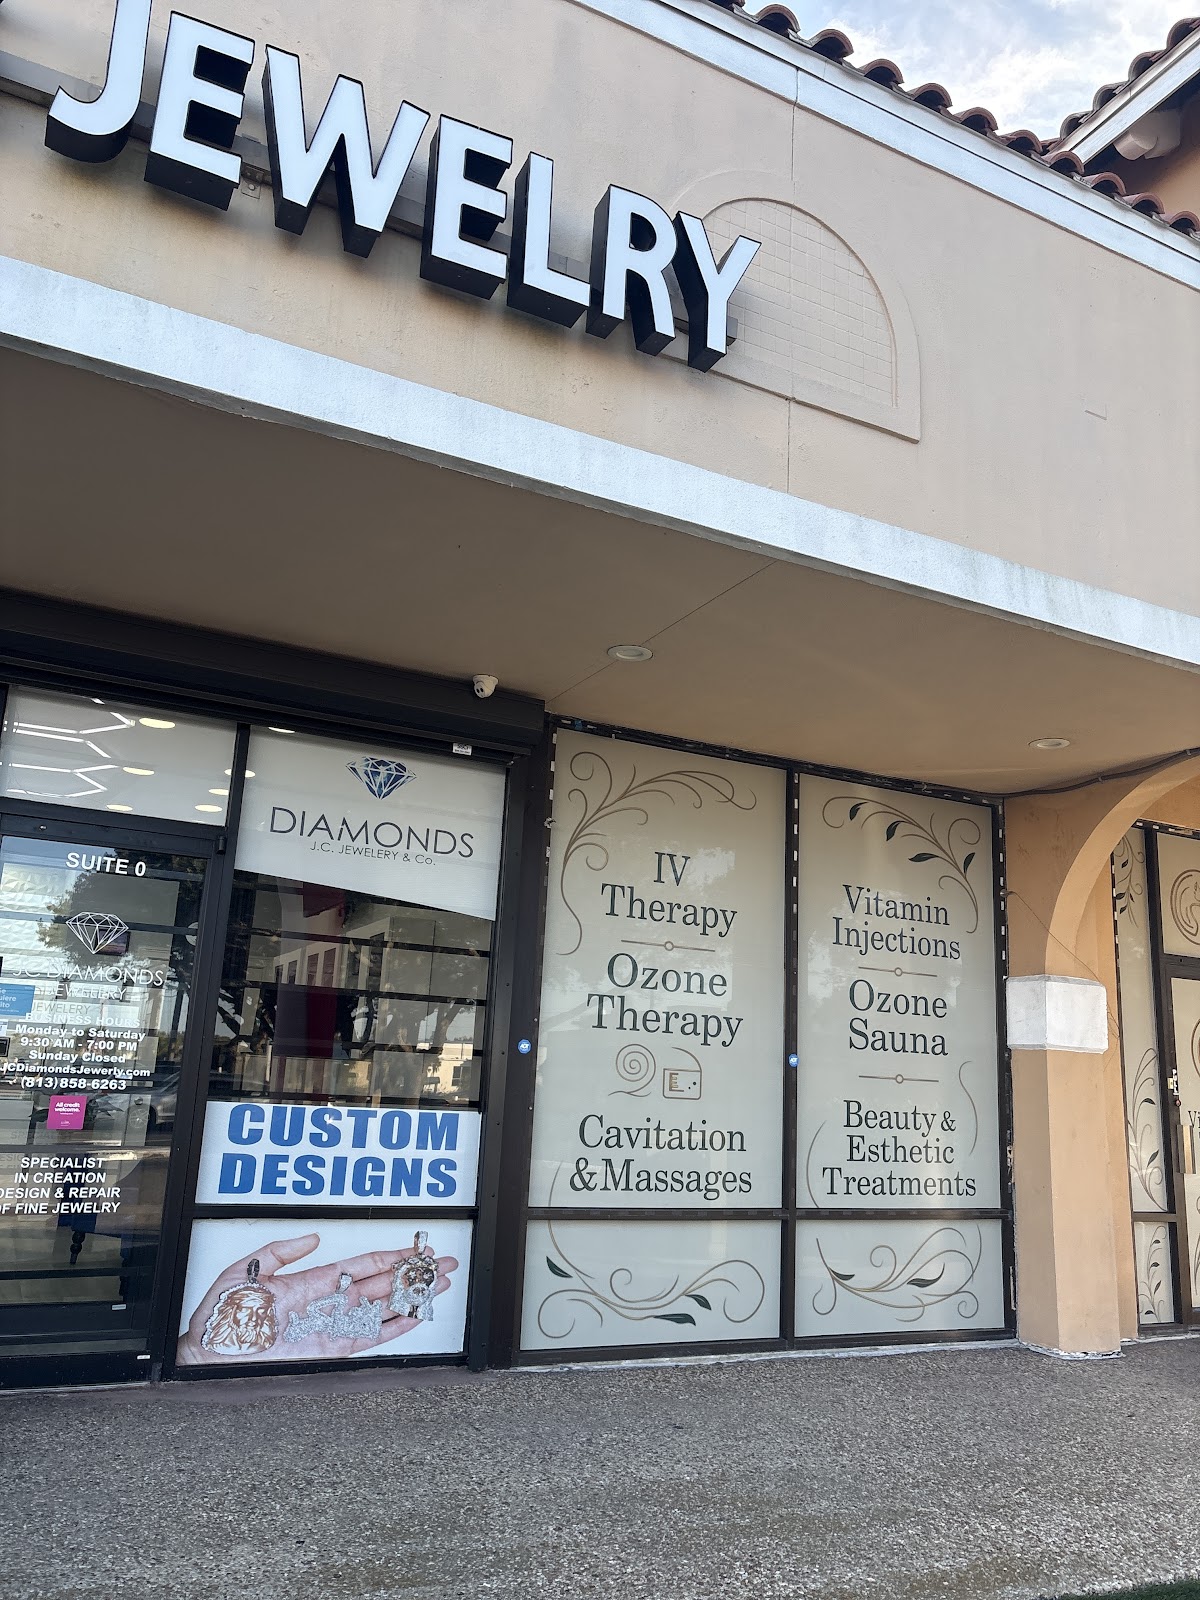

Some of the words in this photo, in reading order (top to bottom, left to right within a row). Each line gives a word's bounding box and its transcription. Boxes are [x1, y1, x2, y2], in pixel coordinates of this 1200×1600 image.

[47, 0, 762, 360] JEWELRY
[269, 806, 474, 858] DIAMONDS
[66, 852, 130, 875] SUITE
[134, 861, 146, 877] 0
[309, 841, 334, 853] J.C.
[338, 844, 399, 861] JEWELERY
[402, 853, 411, 862] &
[415, 854, 436, 866] Co.
[653, 851, 692, 886] IV
[600, 883, 738, 938] Therapy
[841, 884, 951, 926] Vitamin
[832, 916, 962, 960] Injections
[47, 962, 164, 986] DIAMONDS
[606, 952, 728, 997] Ozone
[848, 979, 948, 1019] Ozone
[15, 1024, 67, 1038] Monday
[71, 1028, 85, 1037] to
[88, 1028, 146, 1042] Saturday
[25, 1012, 92, 1025] BUSINESS
[95, 1016, 141, 1028] HOURS
[586, 993, 744, 1048] Therapy
[20, 1037, 50, 1048] 9:30
[53, 1038, 74, 1049] AM
[86, 1040, 115, 1050] 7:00
[117, 1041, 138, 1052] PM
[848, 1017, 949, 1057] Sauna
[0, 1062, 151, 1078] JCDiamondsJewerly.com
[28, 1050, 79, 1064] Sunday
[82, 1052, 126, 1064] Closed
[227, 1103, 460, 1151] CUSTOM
[578, 1114, 748, 1153] Cavitation
[842, 1100, 938, 1137] Beauty
[940, 1109, 956, 1133] &
[20, 1157, 105, 1169] SPECIALIST
[846, 1135, 955, 1164] Esthetic
[14, 1172, 29, 1183] IN
[33, 1172, 106, 1184] CREATION
[217, 1153, 458, 1198] DESIGNS
[822, 1166, 977, 1197] Treatments
[15, 1202, 49, 1214] FINE
[52, 1202, 121, 1214] JEWELRY
[54, 1187, 65, 1199] &
[69, 1187, 121, 1198] REPAIR
